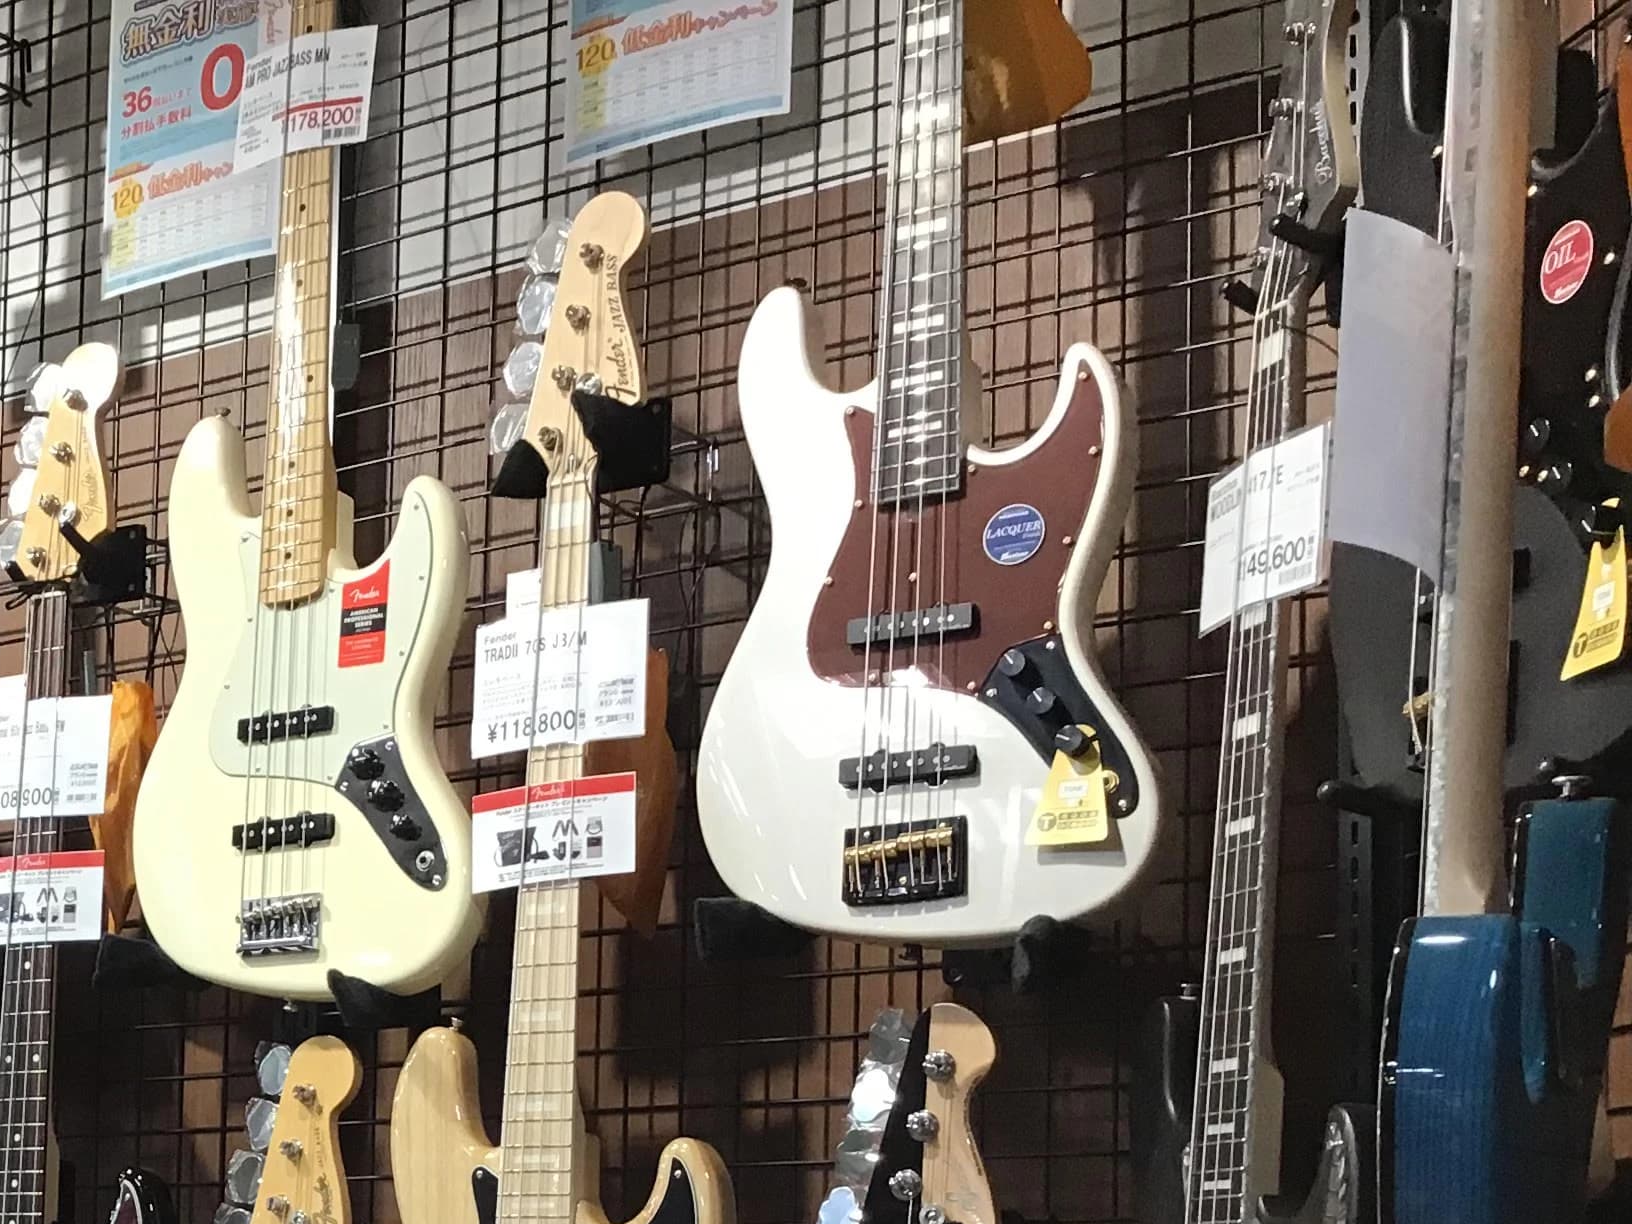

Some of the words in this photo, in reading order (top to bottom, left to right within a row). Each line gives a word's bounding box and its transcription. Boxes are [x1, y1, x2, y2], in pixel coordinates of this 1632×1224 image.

[576, 39, 616, 72] 120
[111, 182, 144, 212] 120
[607, 254, 619, 292] BASS
[1545, 240, 1576, 274] OIL
[611, 297, 628, 332] JAZZ
[986, 520, 1041, 539] LACQUER
[484, 632, 517, 645] Fender
